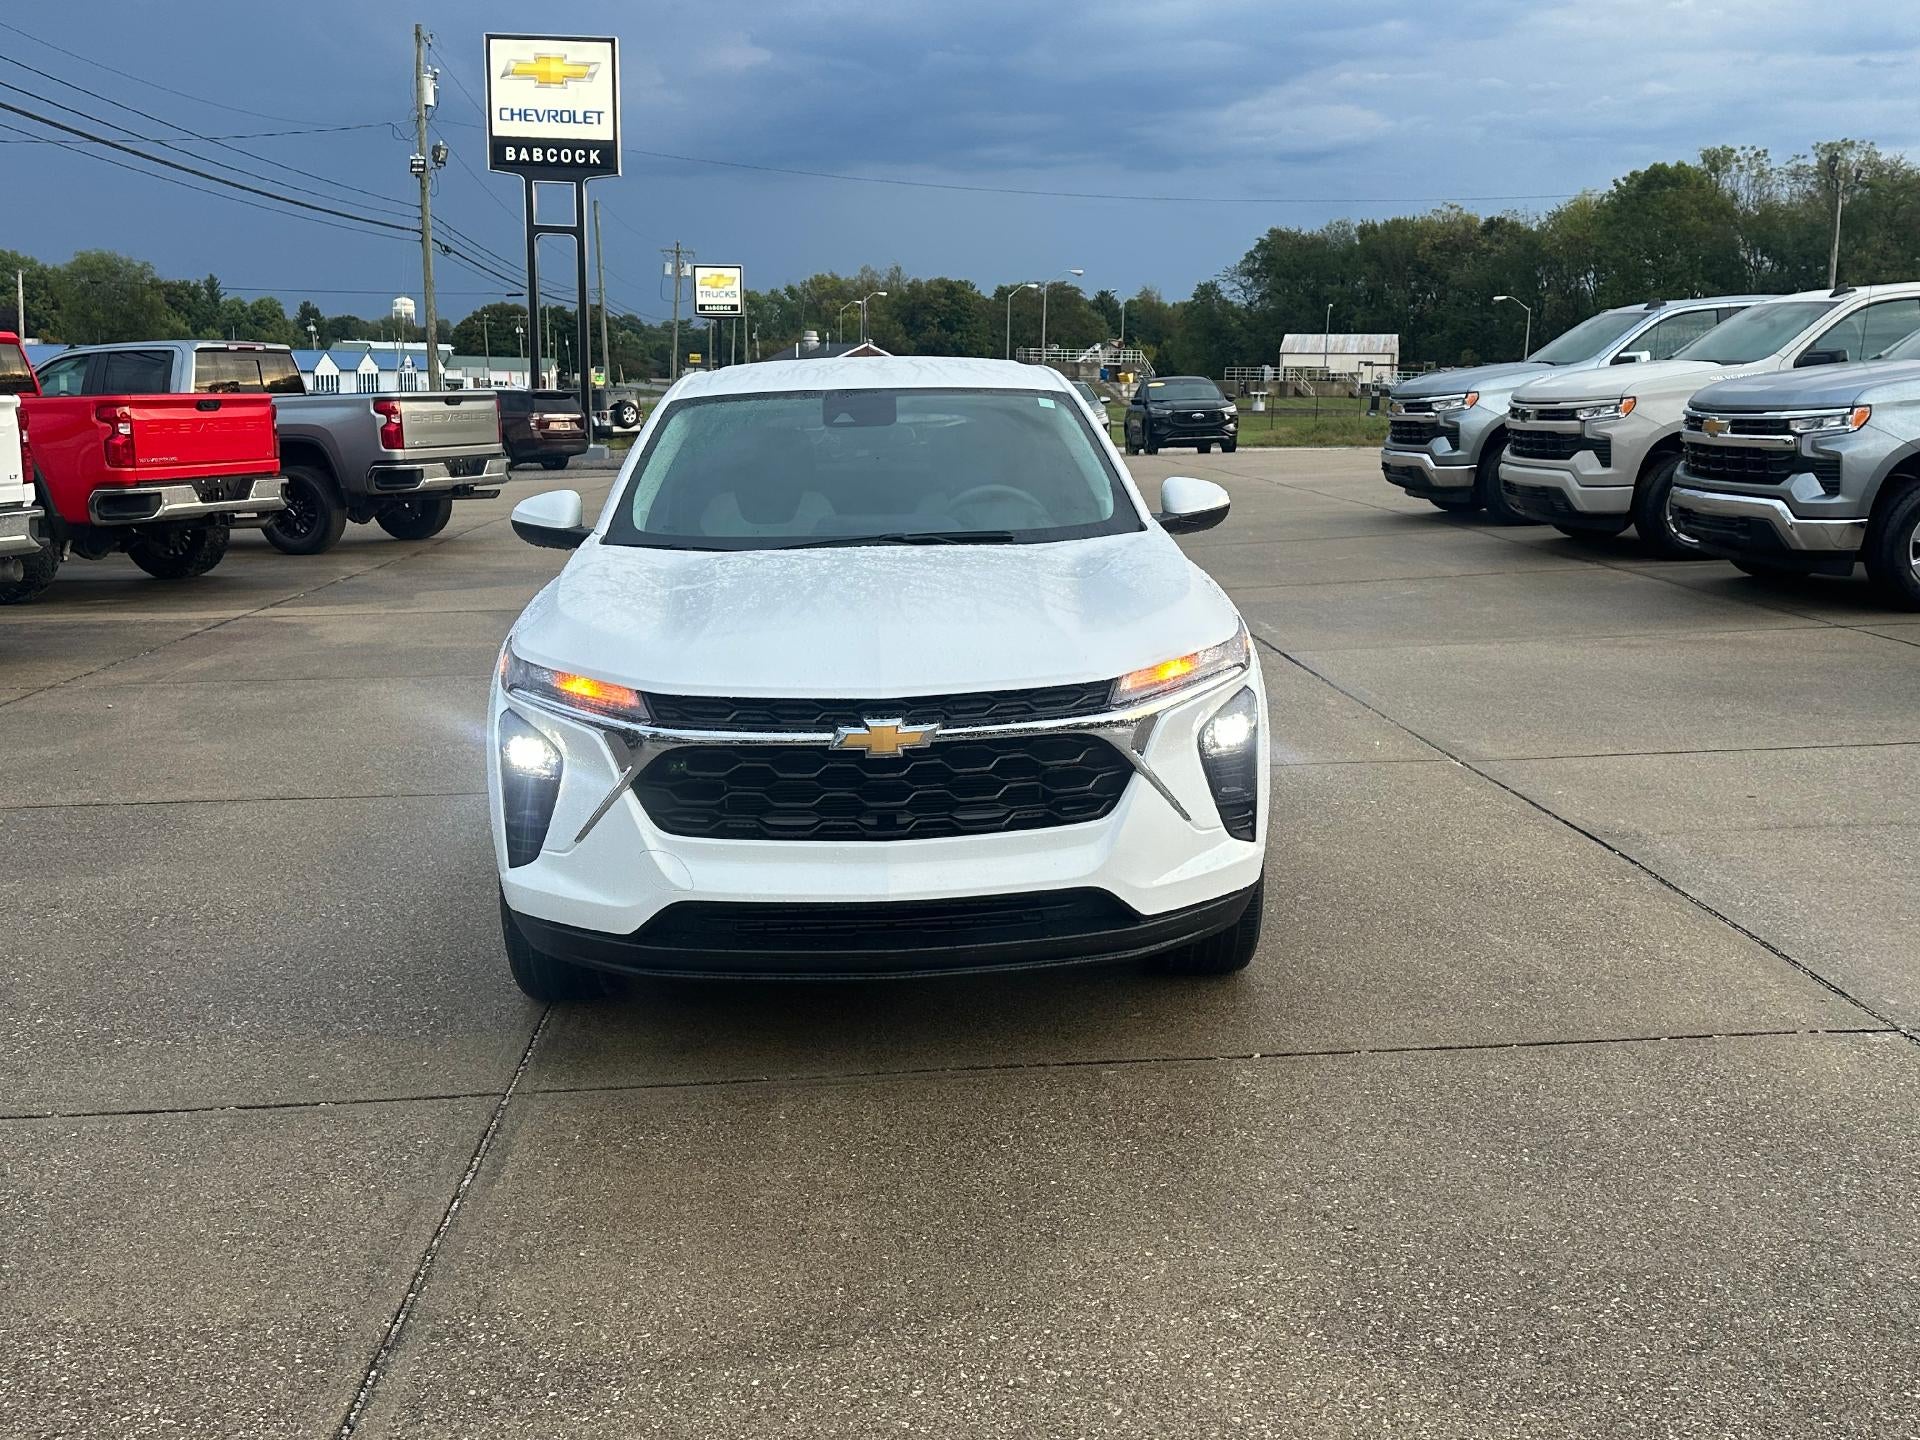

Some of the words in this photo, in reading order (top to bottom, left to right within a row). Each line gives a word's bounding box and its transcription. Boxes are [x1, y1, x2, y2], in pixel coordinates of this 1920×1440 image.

[499, 107, 605, 125] CHEVROLET
[505, 146, 601, 164] BABCOCK
[699, 290, 737, 298] TRUCKS
